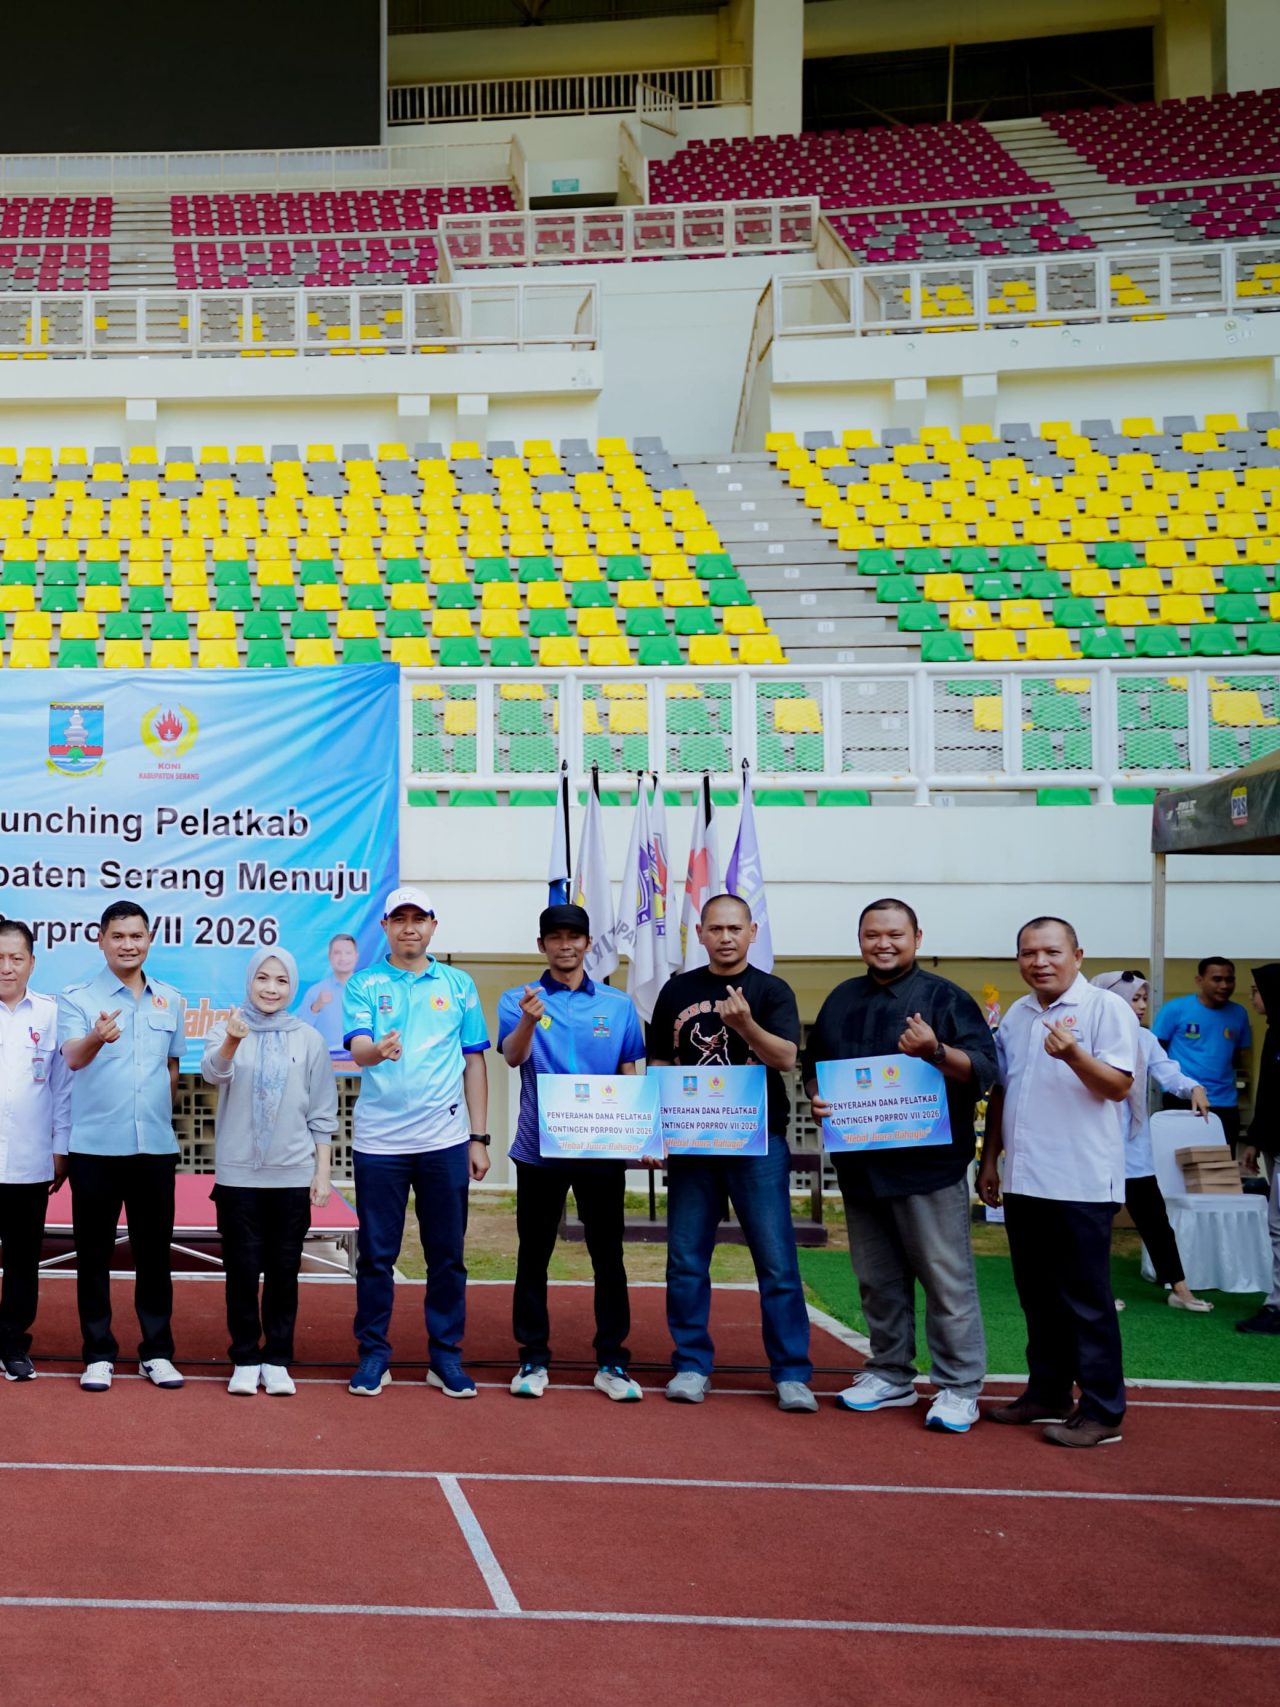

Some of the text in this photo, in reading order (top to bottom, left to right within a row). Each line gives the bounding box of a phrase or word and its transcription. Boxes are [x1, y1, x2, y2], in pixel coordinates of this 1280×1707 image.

[156, 807, 308, 837] Pelatkab
[99, 860, 224, 897] Serang
[238, 862, 370, 899] Menuju
[195, 916, 278, 946] 2026
[879, 1098, 898, 1107] DANA
[900, 1094, 938, 1105] PELATKAB
[547, 1111, 652, 1120] PENYERAHAN DANA PELATKAB
[660, 1107, 757, 1115] ENYERAHAN DANA PELATKAB
[696, 1122, 729, 1130] PORPROV
[831, 1116, 873, 1126] KONTINGEN
[875, 1113, 908, 1122] PORPROV
[547, 1125, 589, 1134] KONTINGEN
[590, 1126, 623, 1134] PORPROV
